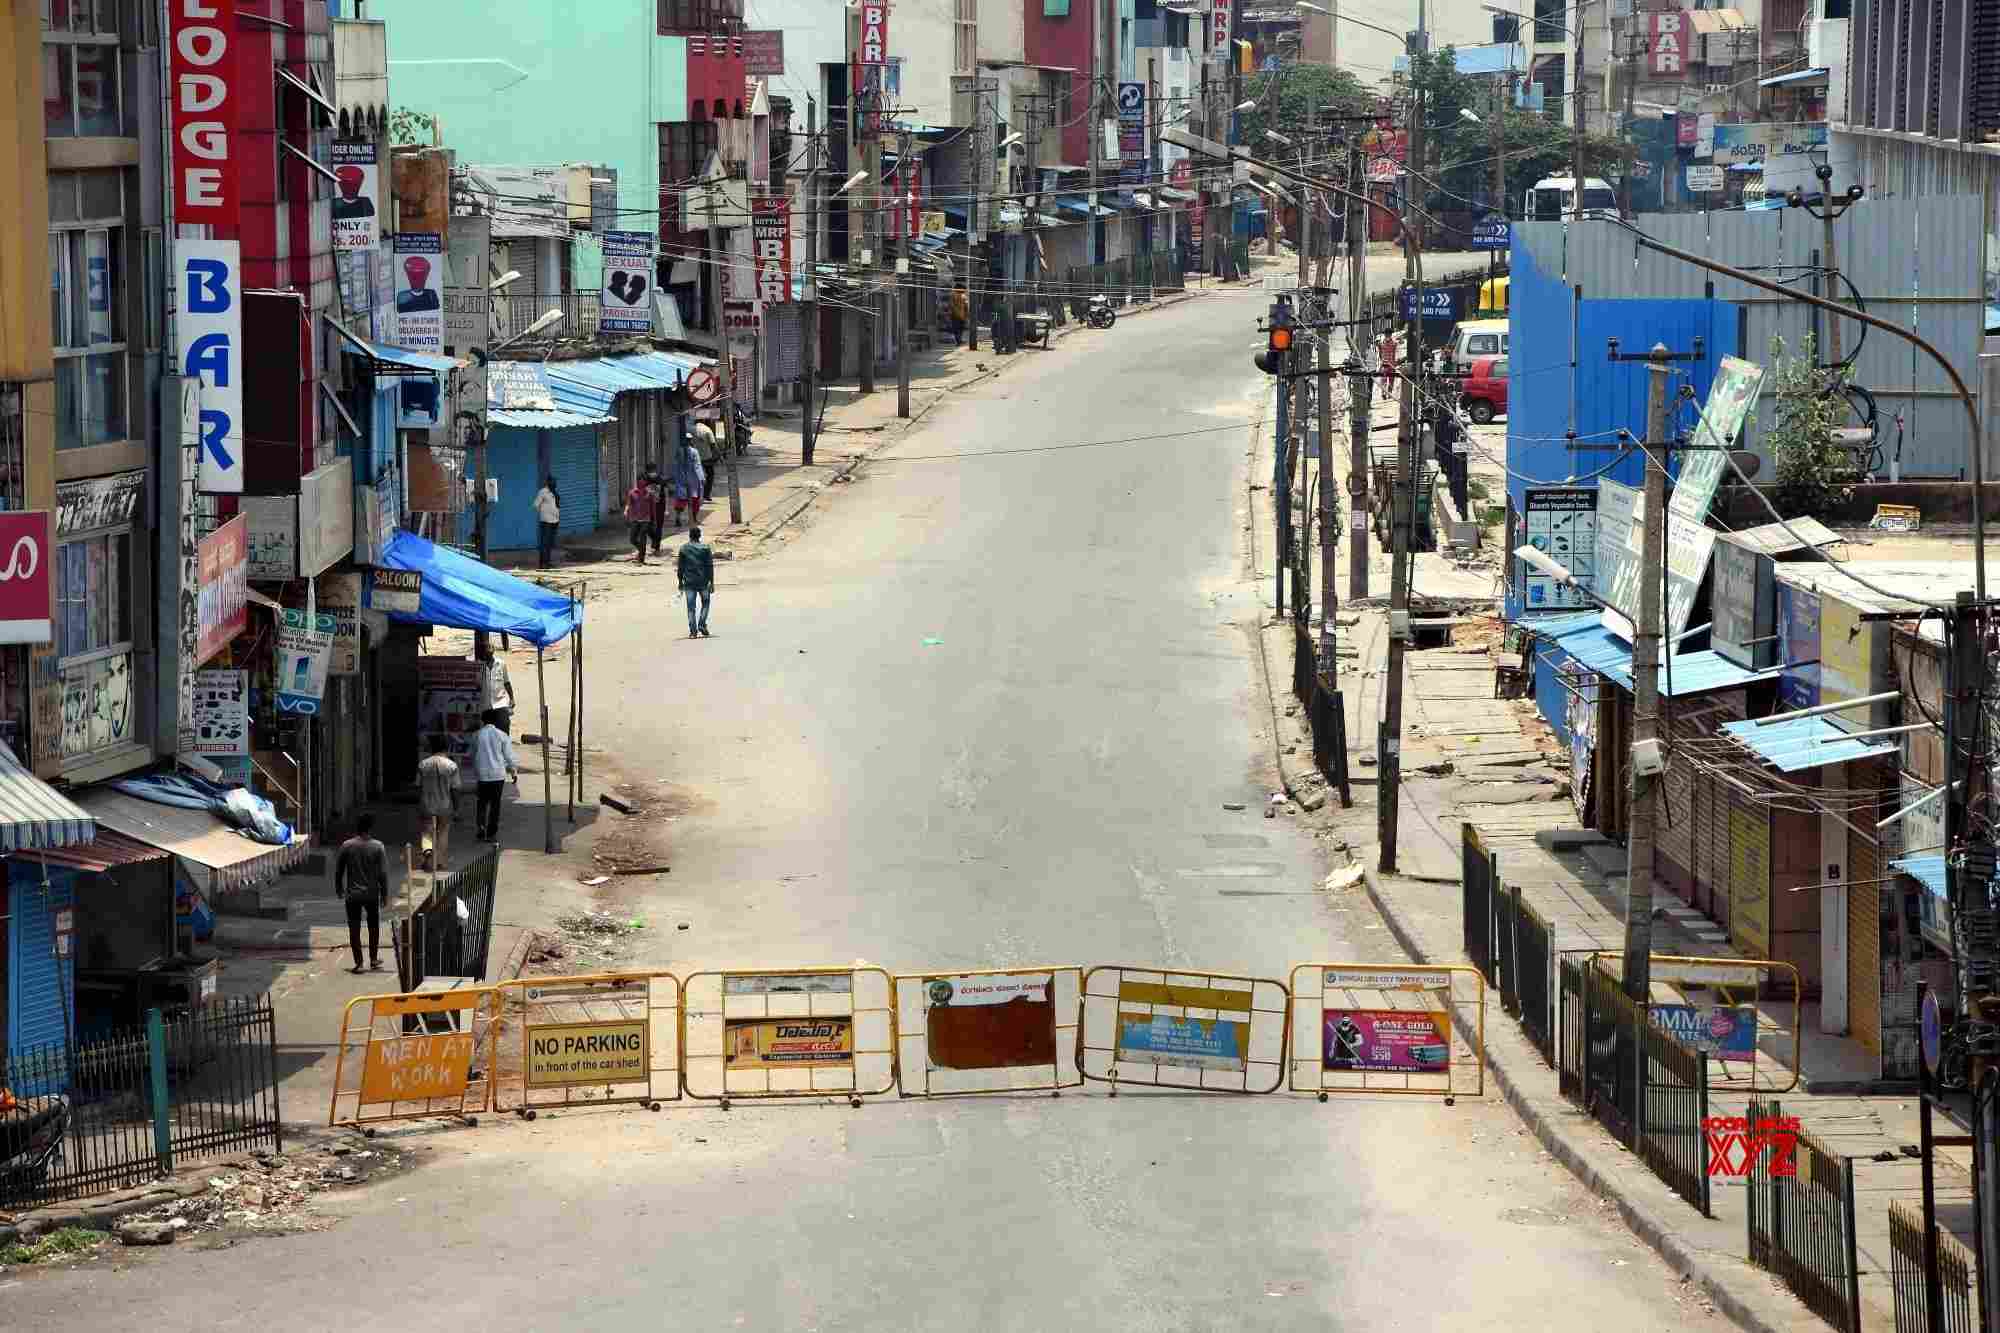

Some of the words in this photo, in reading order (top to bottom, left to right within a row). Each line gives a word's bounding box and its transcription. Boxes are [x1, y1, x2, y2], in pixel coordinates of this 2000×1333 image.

[863, 7, 881, 61] BAR
[1656, 14, 1681, 72] BAR
[754, 227, 787, 239] MRP
[759, 240, 785, 303] BAR
[724, 315, 760, 327] OOMS
[408, 336, 440, 345] MINUTES
[185, 259, 235, 470] BAR
[1423, 975, 1448, 984] POLICE
[1406, 1021, 1434, 1030] GOLD
[380, 1039, 433, 1065] MEN
[534, 1038, 559, 1056] NO
[564, 1033, 641, 1055] PARKING
[535, 1064, 544, 1072] in
[546, 1062, 568, 1073] front
[570, 1061, 580, 1072] of
[582, 1059, 598, 1070] the
[599, 1060, 613, 1069] car
[615, 1056, 640, 1068] shed
[391, 1063, 451, 1090] WORK
